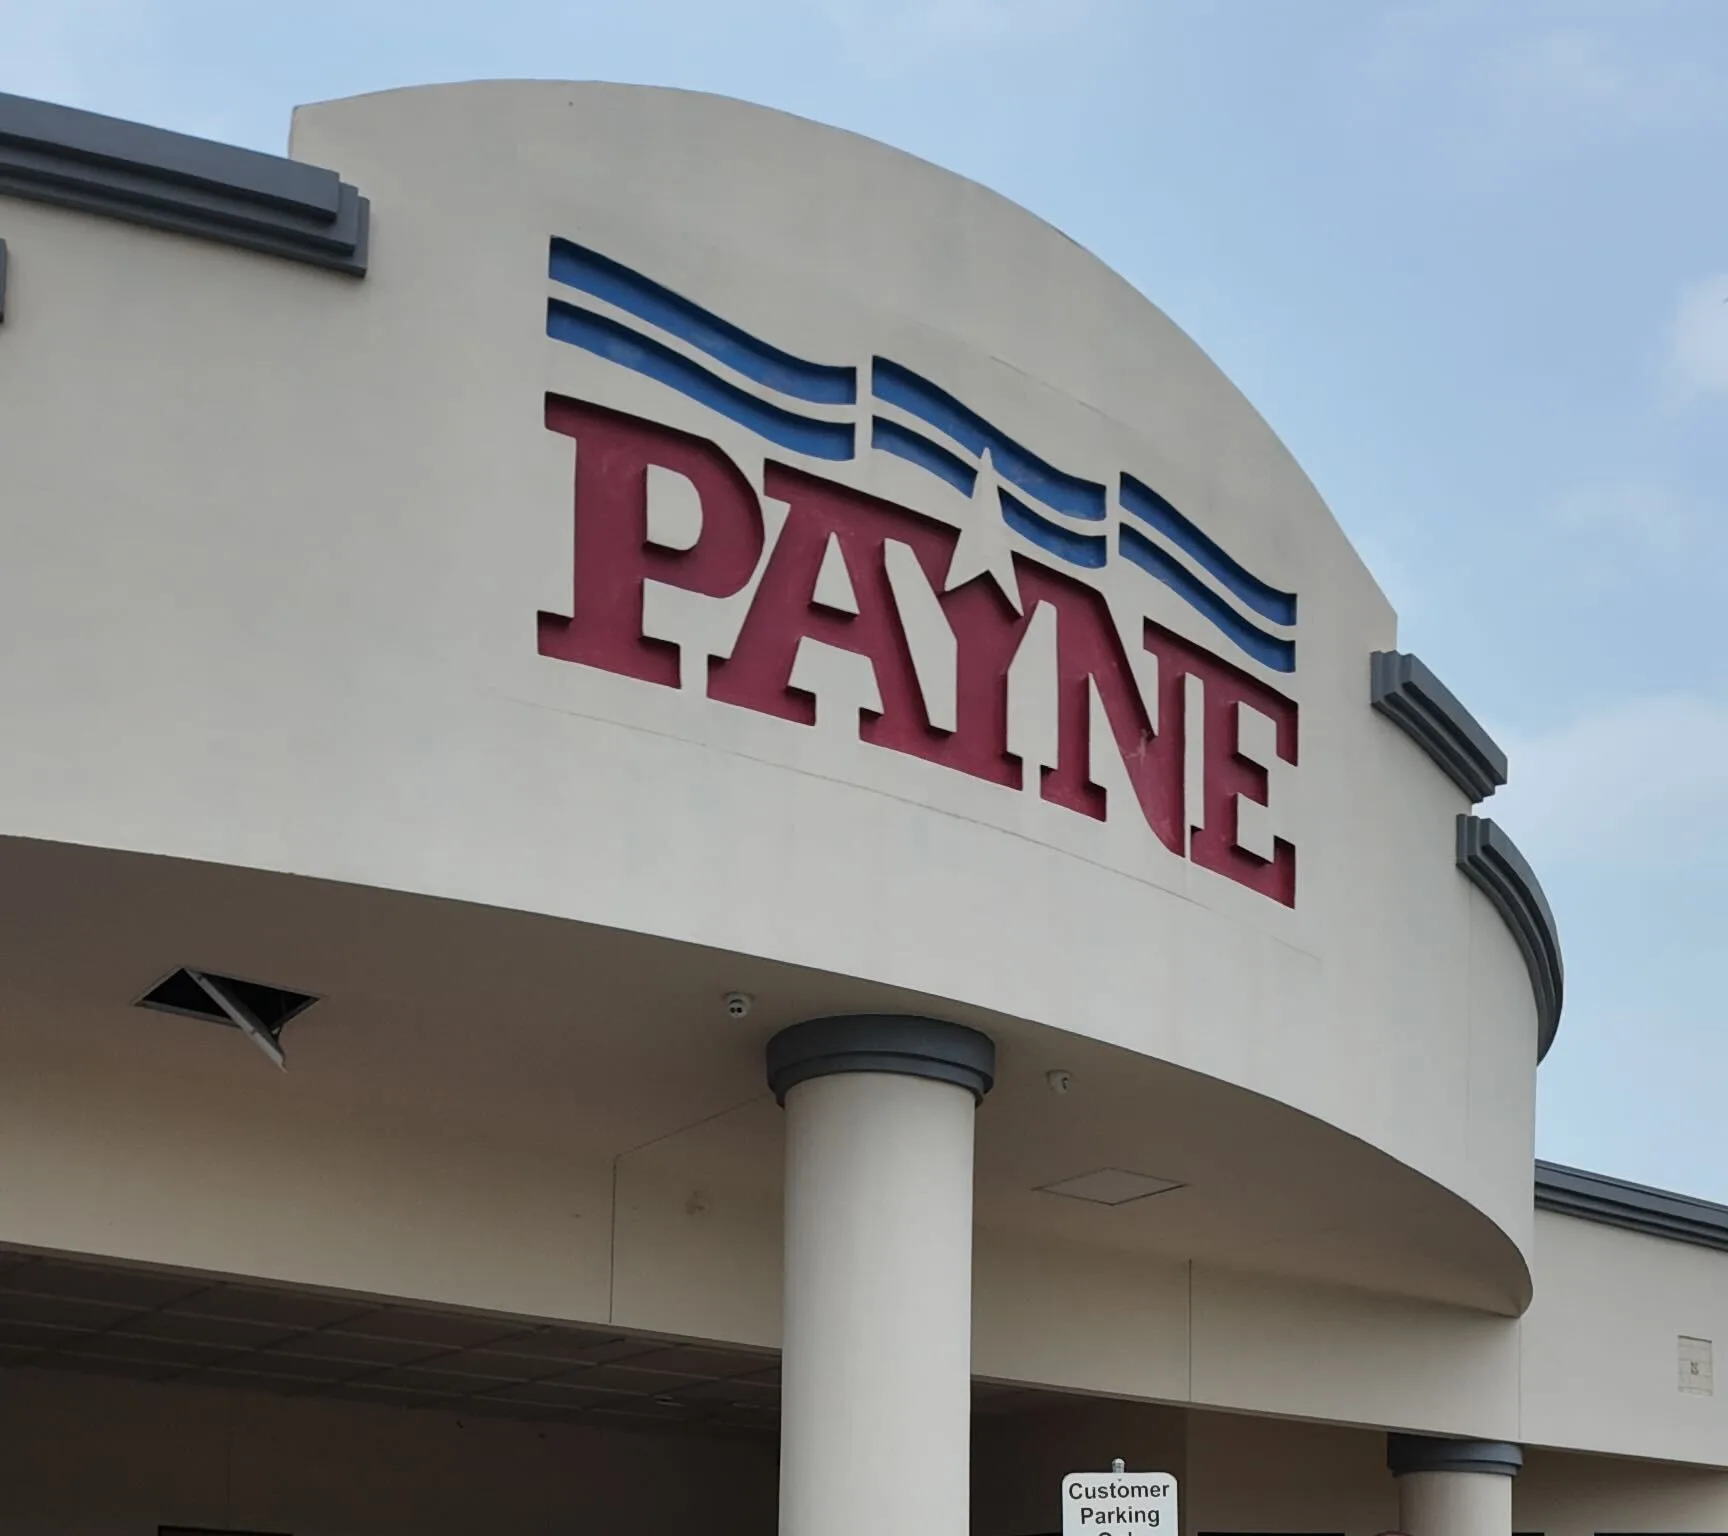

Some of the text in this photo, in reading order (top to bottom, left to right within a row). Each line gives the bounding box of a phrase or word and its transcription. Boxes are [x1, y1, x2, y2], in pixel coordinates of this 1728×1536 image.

[536, 391, 1299, 909] PAYNE
[1069, 1482, 1170, 1500] Customer
[1080, 1506, 1160, 1527] Parking
